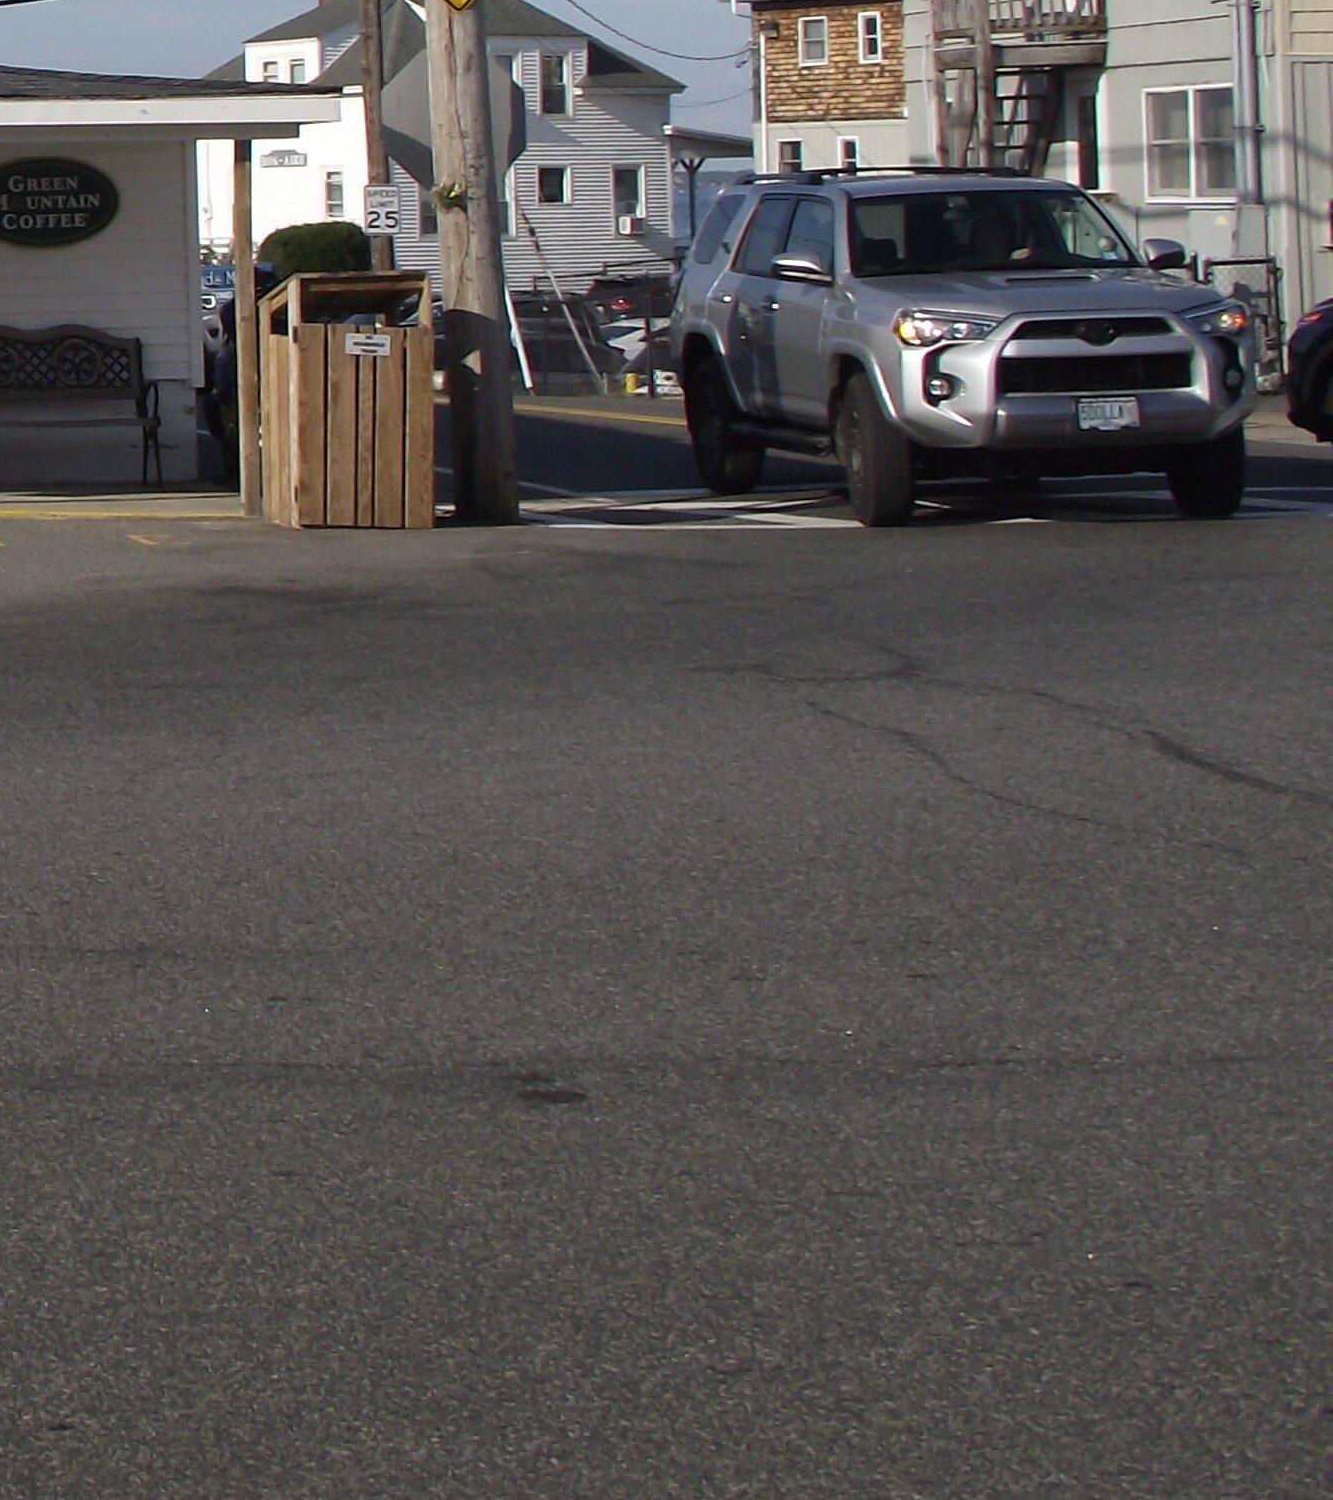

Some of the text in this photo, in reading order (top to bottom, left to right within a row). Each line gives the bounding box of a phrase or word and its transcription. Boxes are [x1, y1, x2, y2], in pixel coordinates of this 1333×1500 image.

[7, 175, 78, 192] GREEN
[368, 189, 397, 198] SPEED
[369, 200, 395, 209] LIMIT
[2, 213, 86, 230] COFFEE
[368, 211, 398, 229] 25
